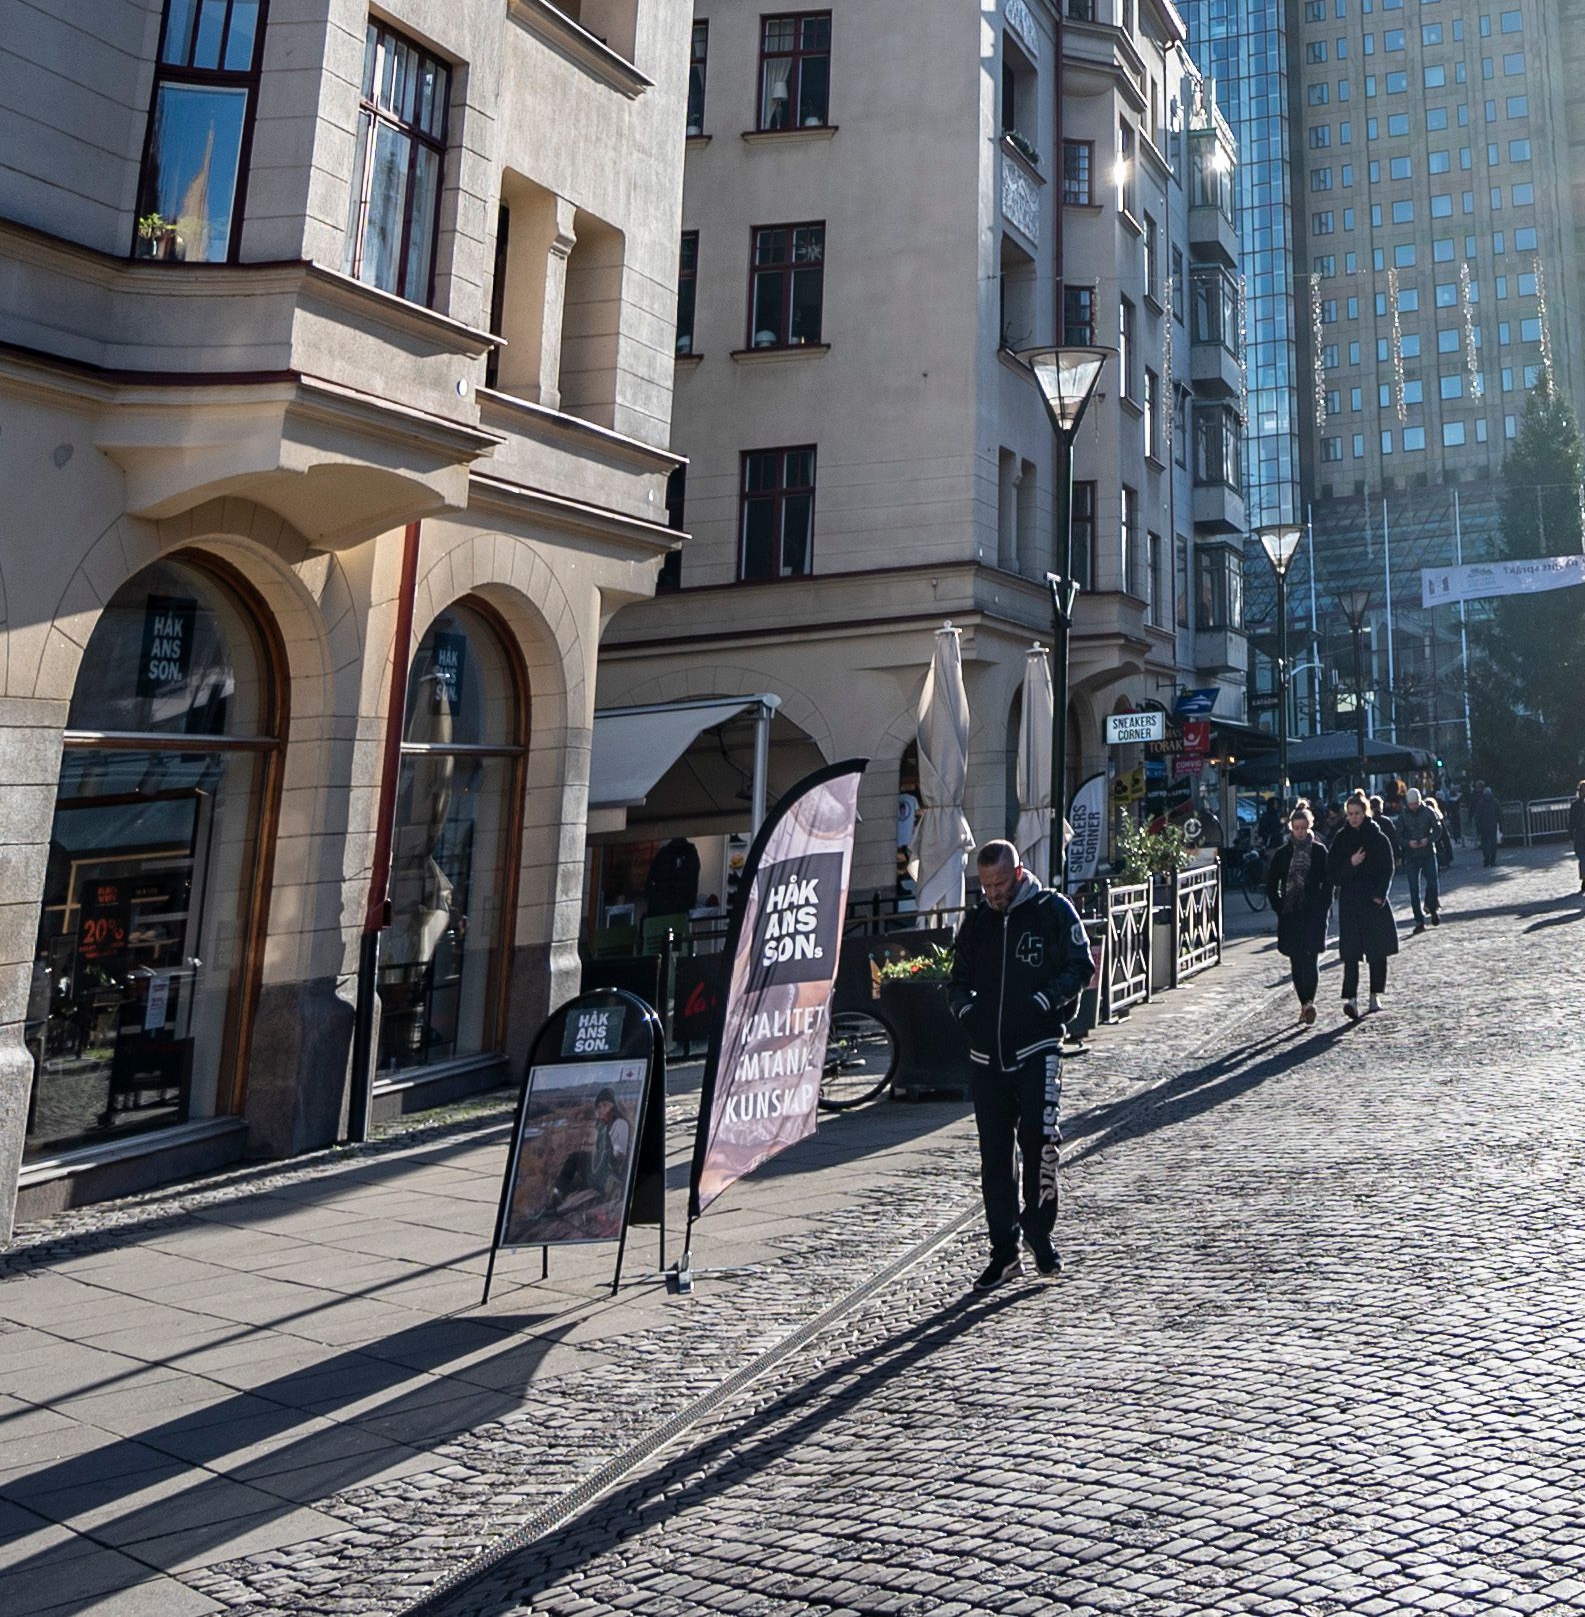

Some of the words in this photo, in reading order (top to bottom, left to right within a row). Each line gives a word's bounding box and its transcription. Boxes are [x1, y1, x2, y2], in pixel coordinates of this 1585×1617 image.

[154, 611, 184, 638] HÅK
[151, 638, 182, 659] ANS
[439, 645, 458, 667] HÅK
[1112, 715, 1157, 730] SNEAKERS
[1118, 728, 1152, 742] CORNER
[1149, 738, 1184, 754] TOBAK
[1070, 804, 1087, 874] SNEAKERS
[1084, 811, 1101, 863] CORNER
[766, 875, 819, 914] HÅK
[764, 906, 817, 940] ANS
[1016, 932, 1044, 968] 45
[578, 1010, 610, 1028] HÅK
[576, 1025, 607, 1040] ANS
[725, 1084, 814, 1125] KUNSKAP
